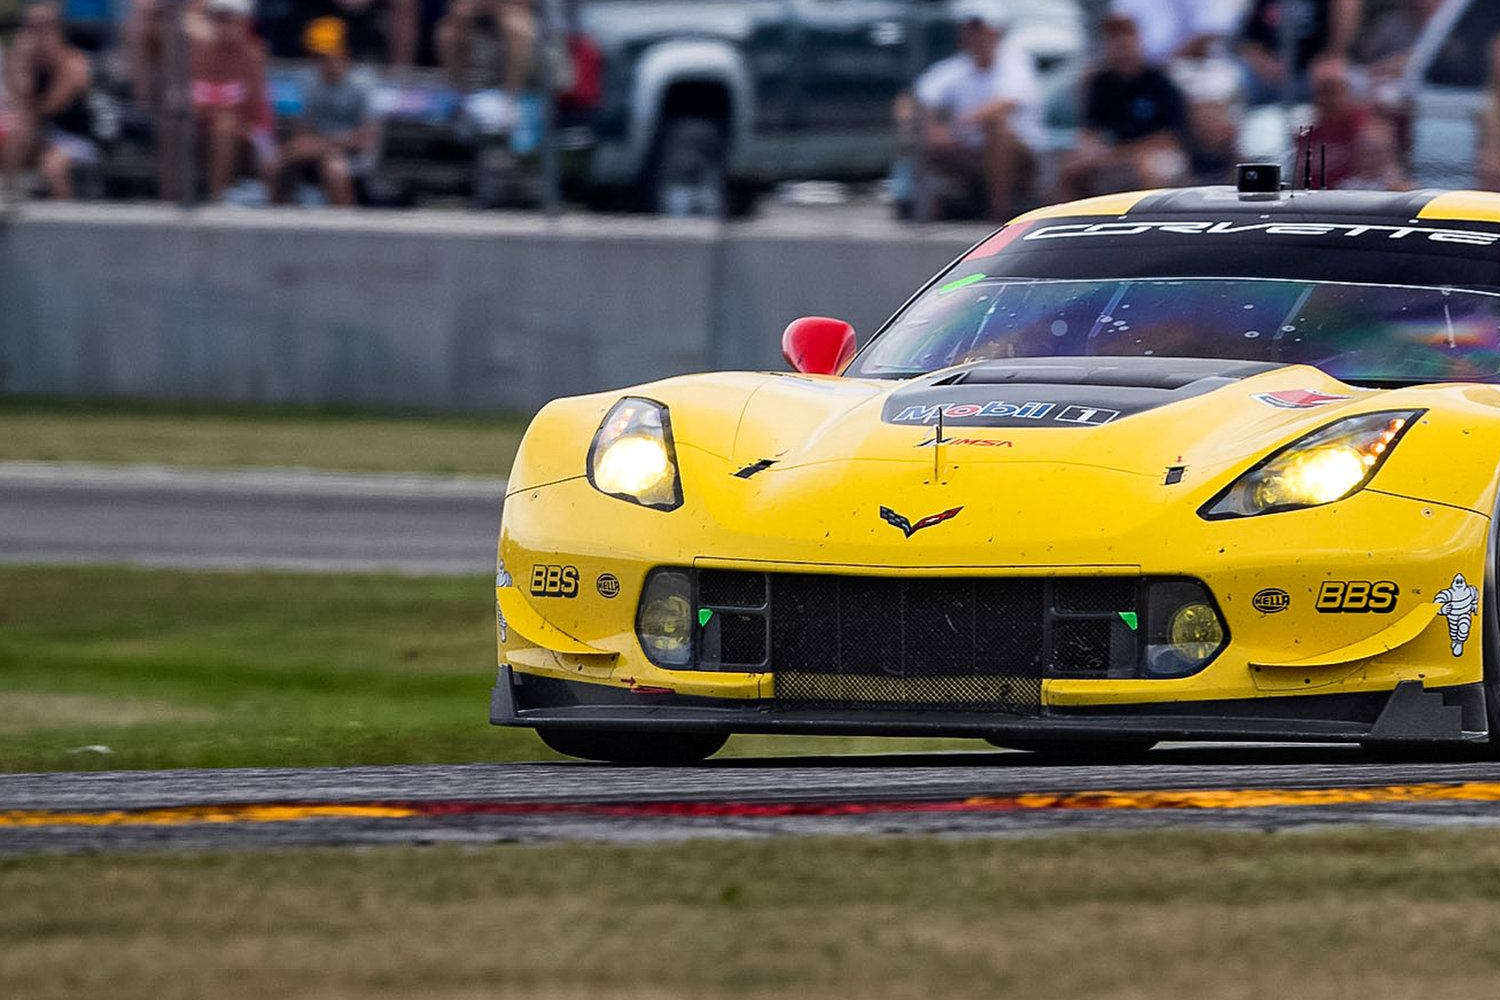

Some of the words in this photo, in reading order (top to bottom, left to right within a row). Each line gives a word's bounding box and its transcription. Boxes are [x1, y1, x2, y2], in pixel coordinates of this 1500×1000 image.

[892, 401, 1056, 424] Mobil
[530, 564, 580, 598] BBS
[1315, 580, 1400, 613] BBS
